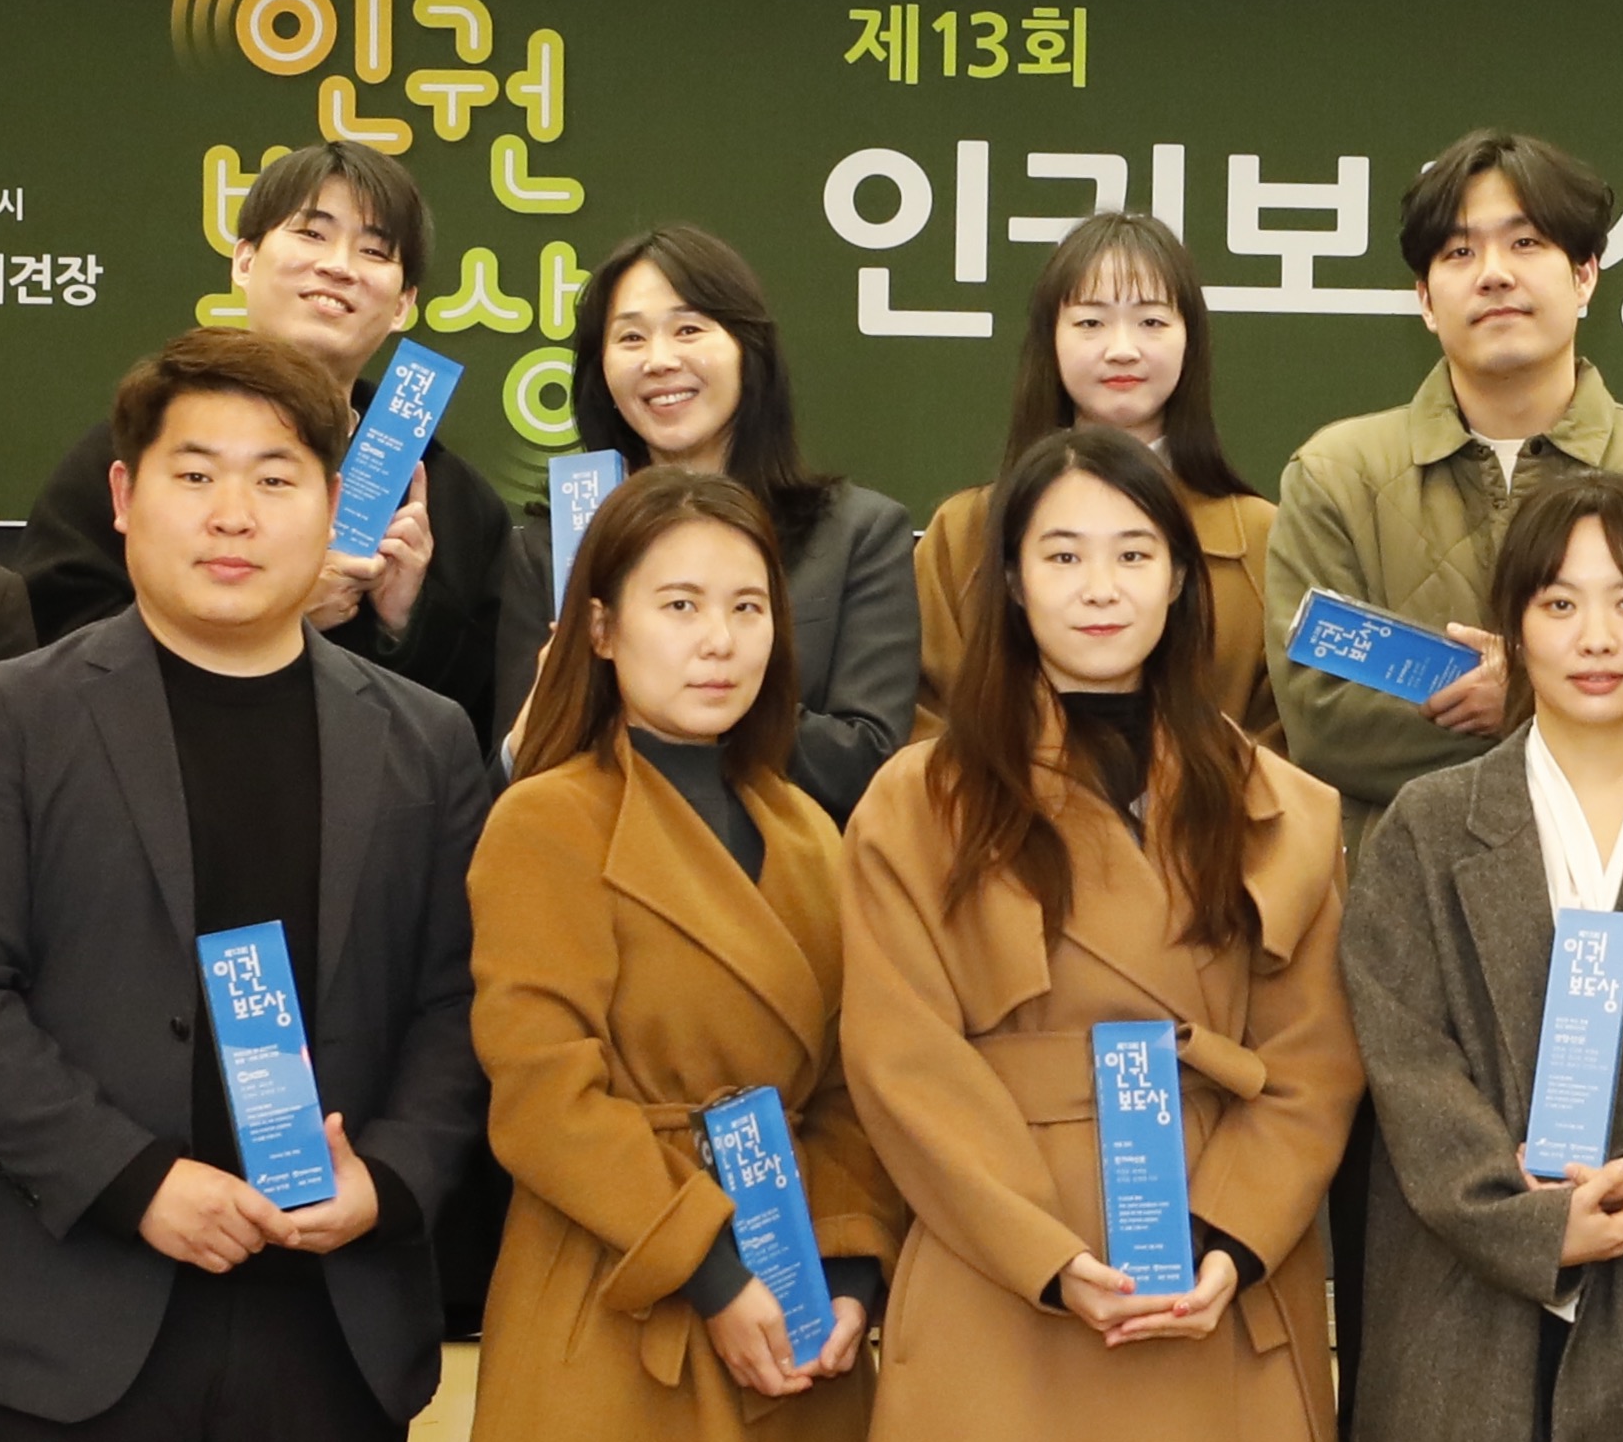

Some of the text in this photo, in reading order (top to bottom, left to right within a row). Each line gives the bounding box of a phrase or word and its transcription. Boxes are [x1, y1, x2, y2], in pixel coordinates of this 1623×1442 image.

[844, 4, 1088, 88] 제13회
[395, 365, 438, 406] 인권
[388, 399, 433, 439] 보도상
[562, 470, 600, 511] 인권
[1314, 620, 1358, 658] 인권
[1348, 621, 1392, 663] 보도상
[213, 944, 268, 996] 인권
[1563, 931, 1608, 975] 인권
[234, 993, 292, 1027] 보도상
[1568, 976, 1620, 1014] 보도상
[1105, 1042, 1152, 1089] 인권
[1118, 1089, 1171, 1126] 보도상
[724, 1112, 767, 1167] 인권
[741, 1153, 787, 1189] 보도상
